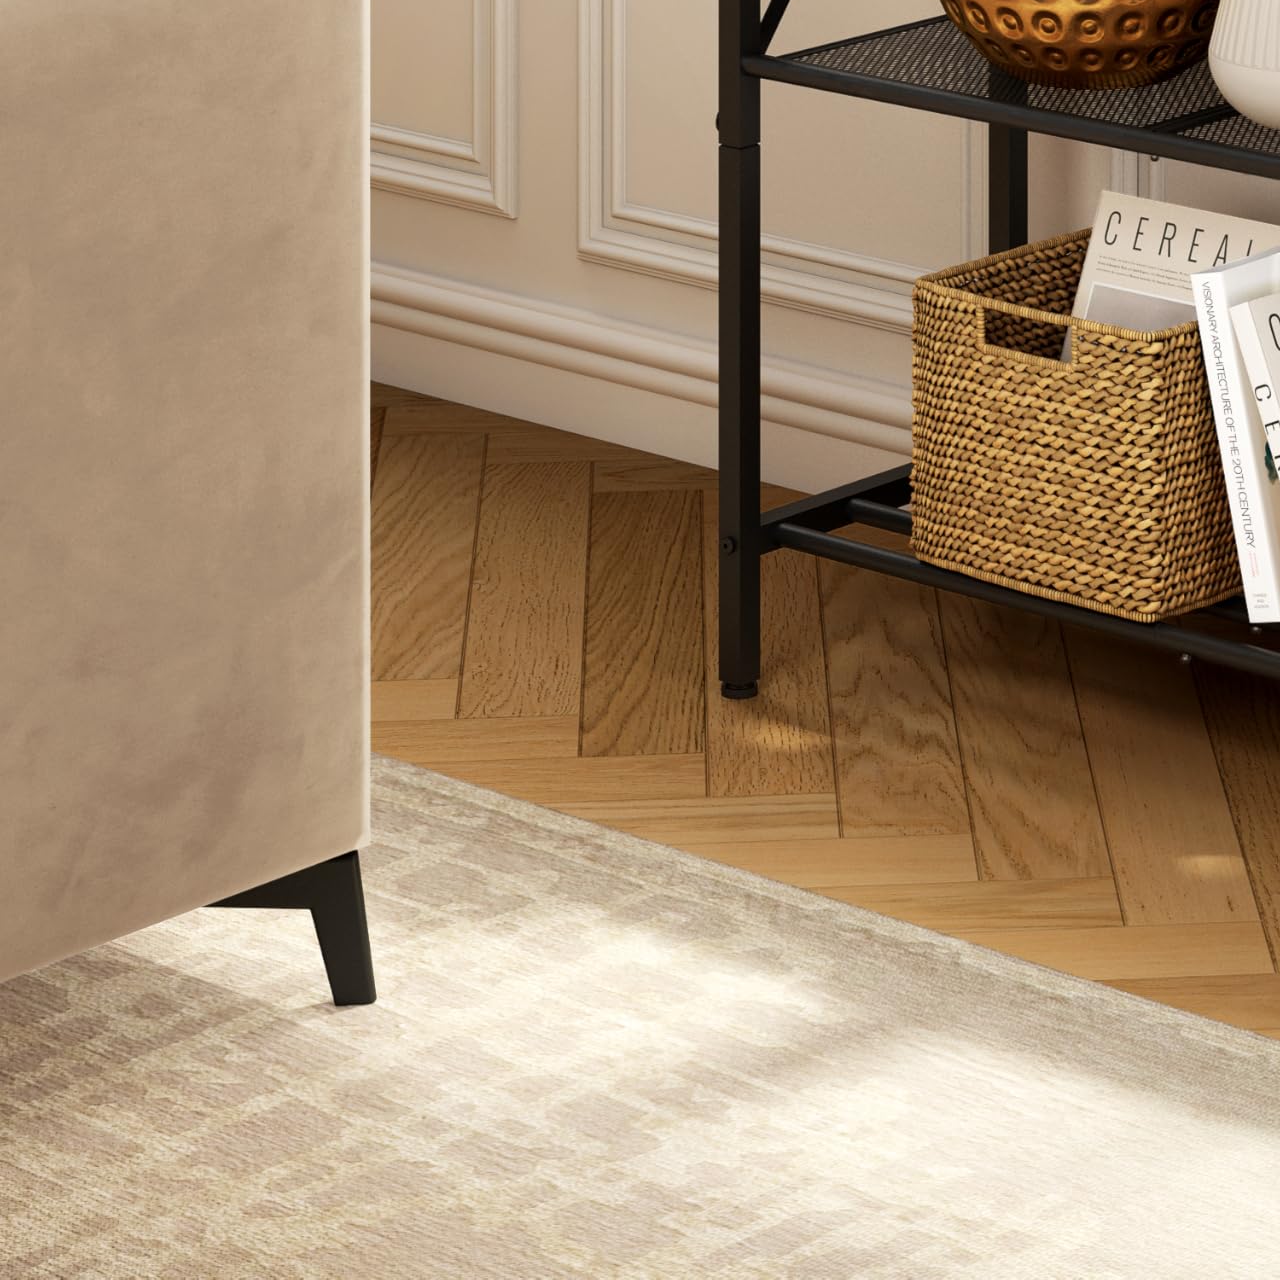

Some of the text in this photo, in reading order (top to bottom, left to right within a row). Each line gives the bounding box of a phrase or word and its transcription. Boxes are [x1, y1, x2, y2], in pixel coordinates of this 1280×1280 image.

[1202, 281, 1218, 334] VISIONARY
[1210, 334, 1233, 416] ARCHITECTURE
[1225, 417, 1236, 433] OF
[1229, 433, 1241, 457] THE
[1231, 458, 1246, 490] 20TH
[1238, 491, 1256, 549] CENTURY
